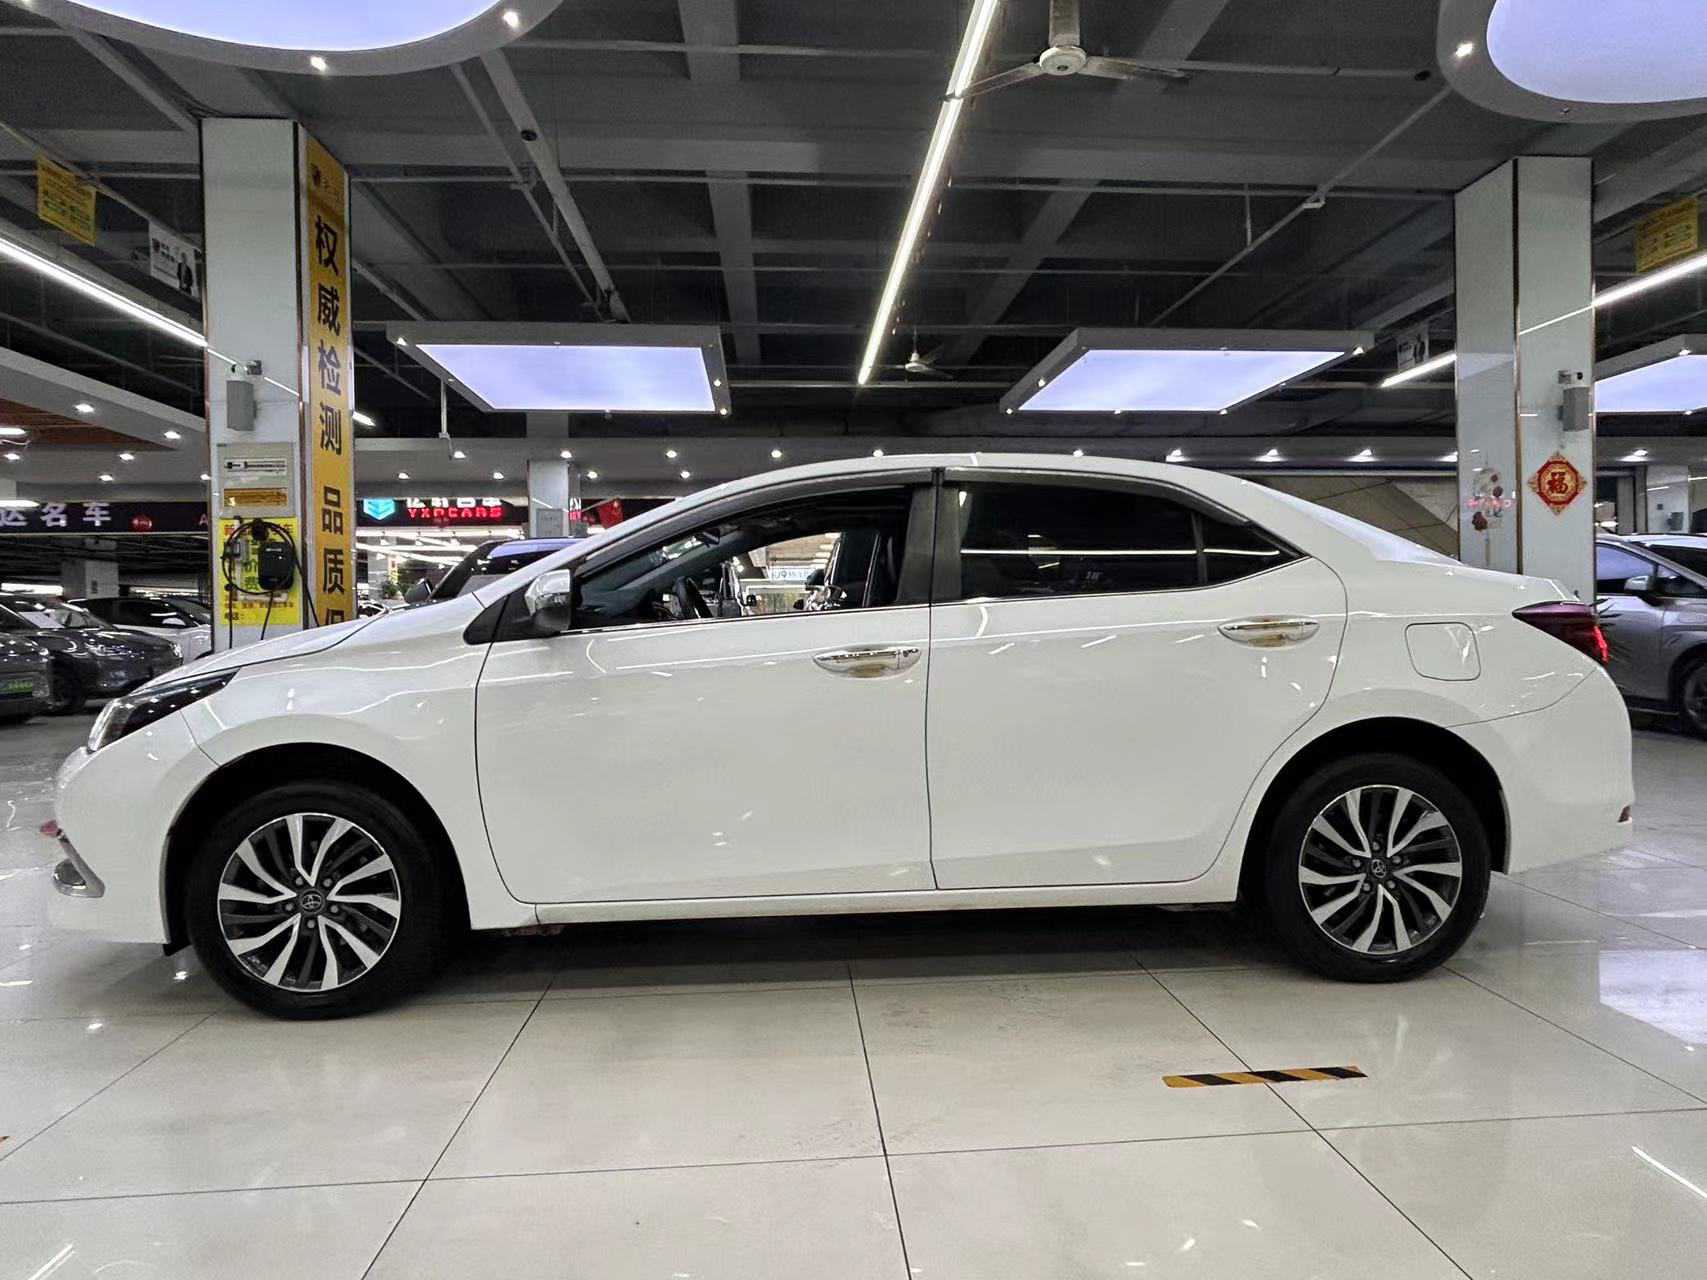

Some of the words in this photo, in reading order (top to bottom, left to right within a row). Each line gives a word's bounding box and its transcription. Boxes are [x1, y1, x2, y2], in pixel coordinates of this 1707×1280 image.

[314, 213, 342, 456] 权威检测
[1547, 471, 1569, 495] 福
